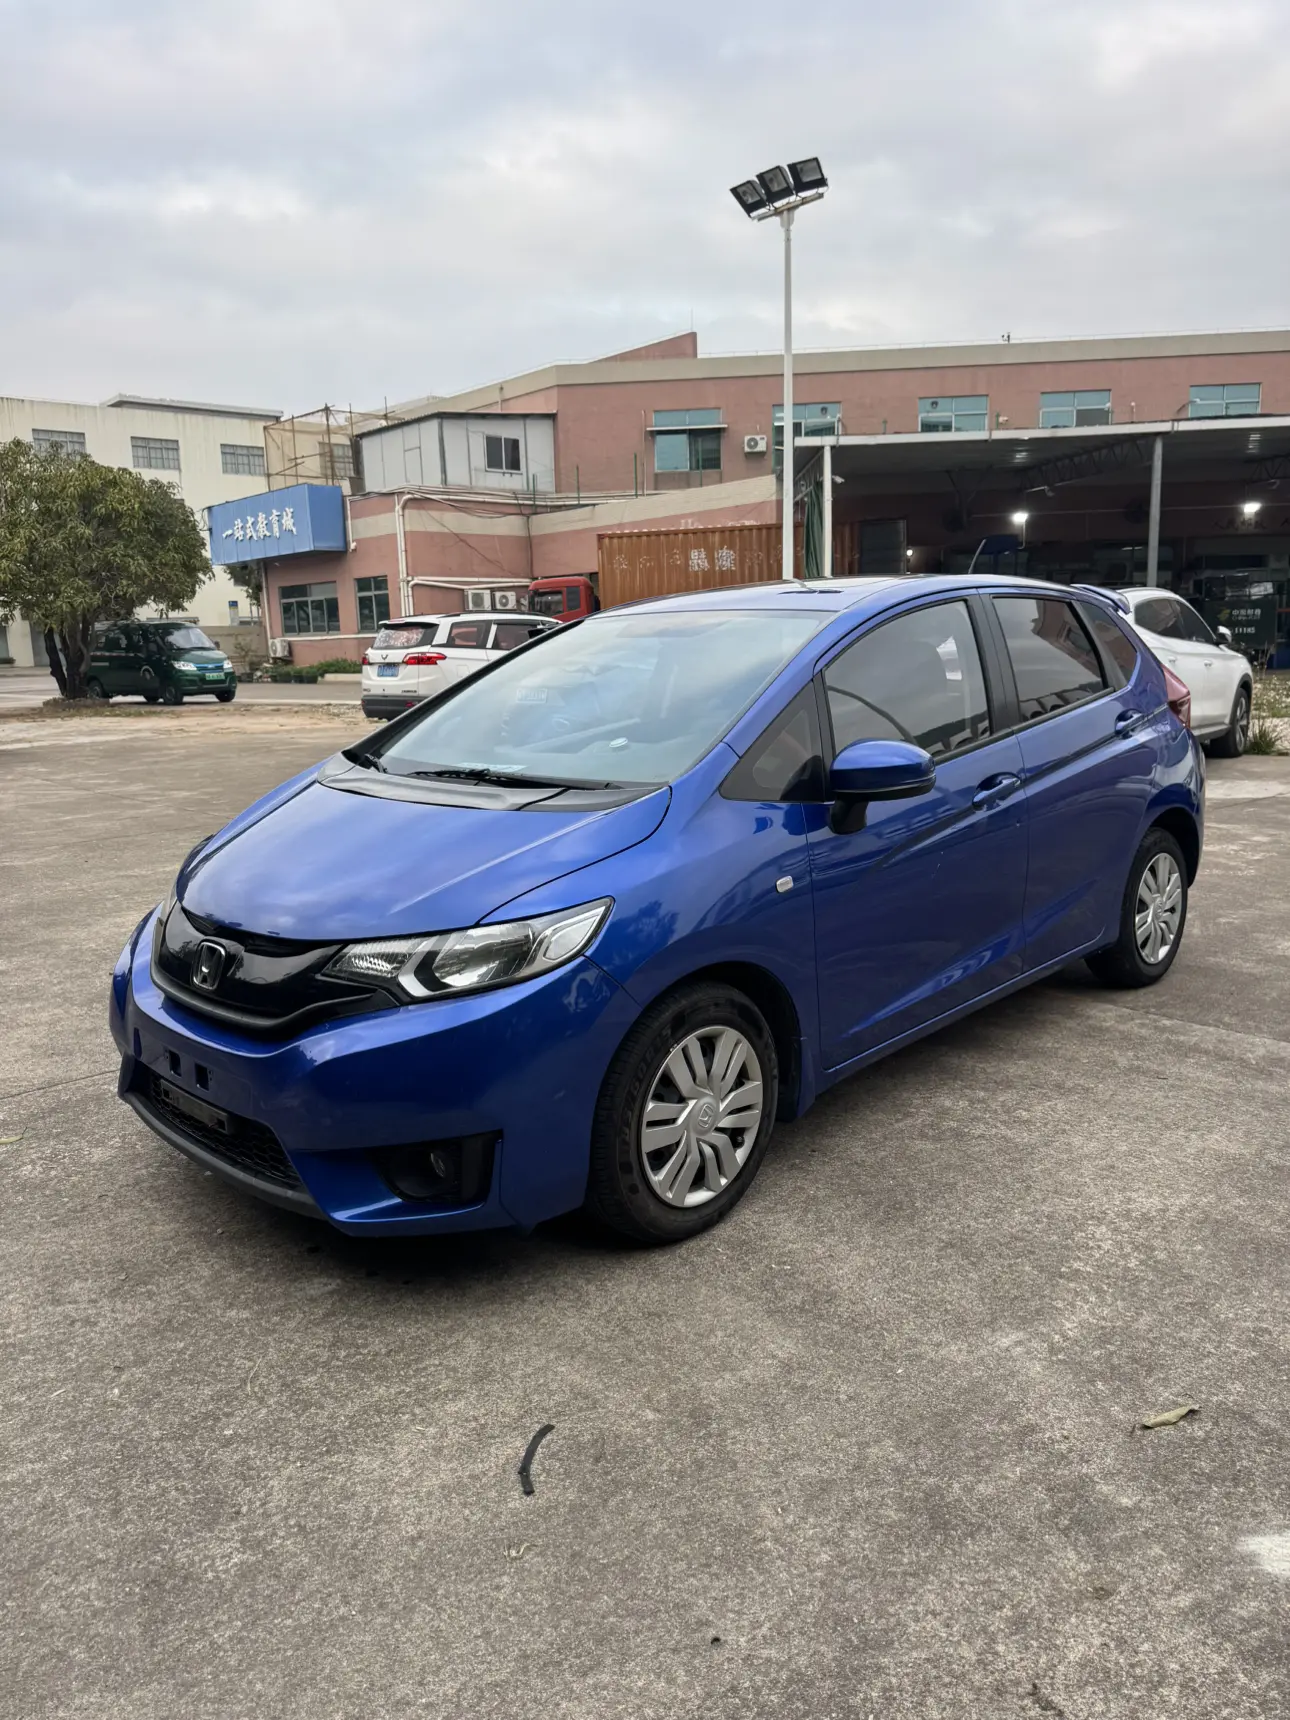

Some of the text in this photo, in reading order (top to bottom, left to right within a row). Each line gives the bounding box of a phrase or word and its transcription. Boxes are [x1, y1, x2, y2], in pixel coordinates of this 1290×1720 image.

[222, 507, 297, 541] 一站式教育城
